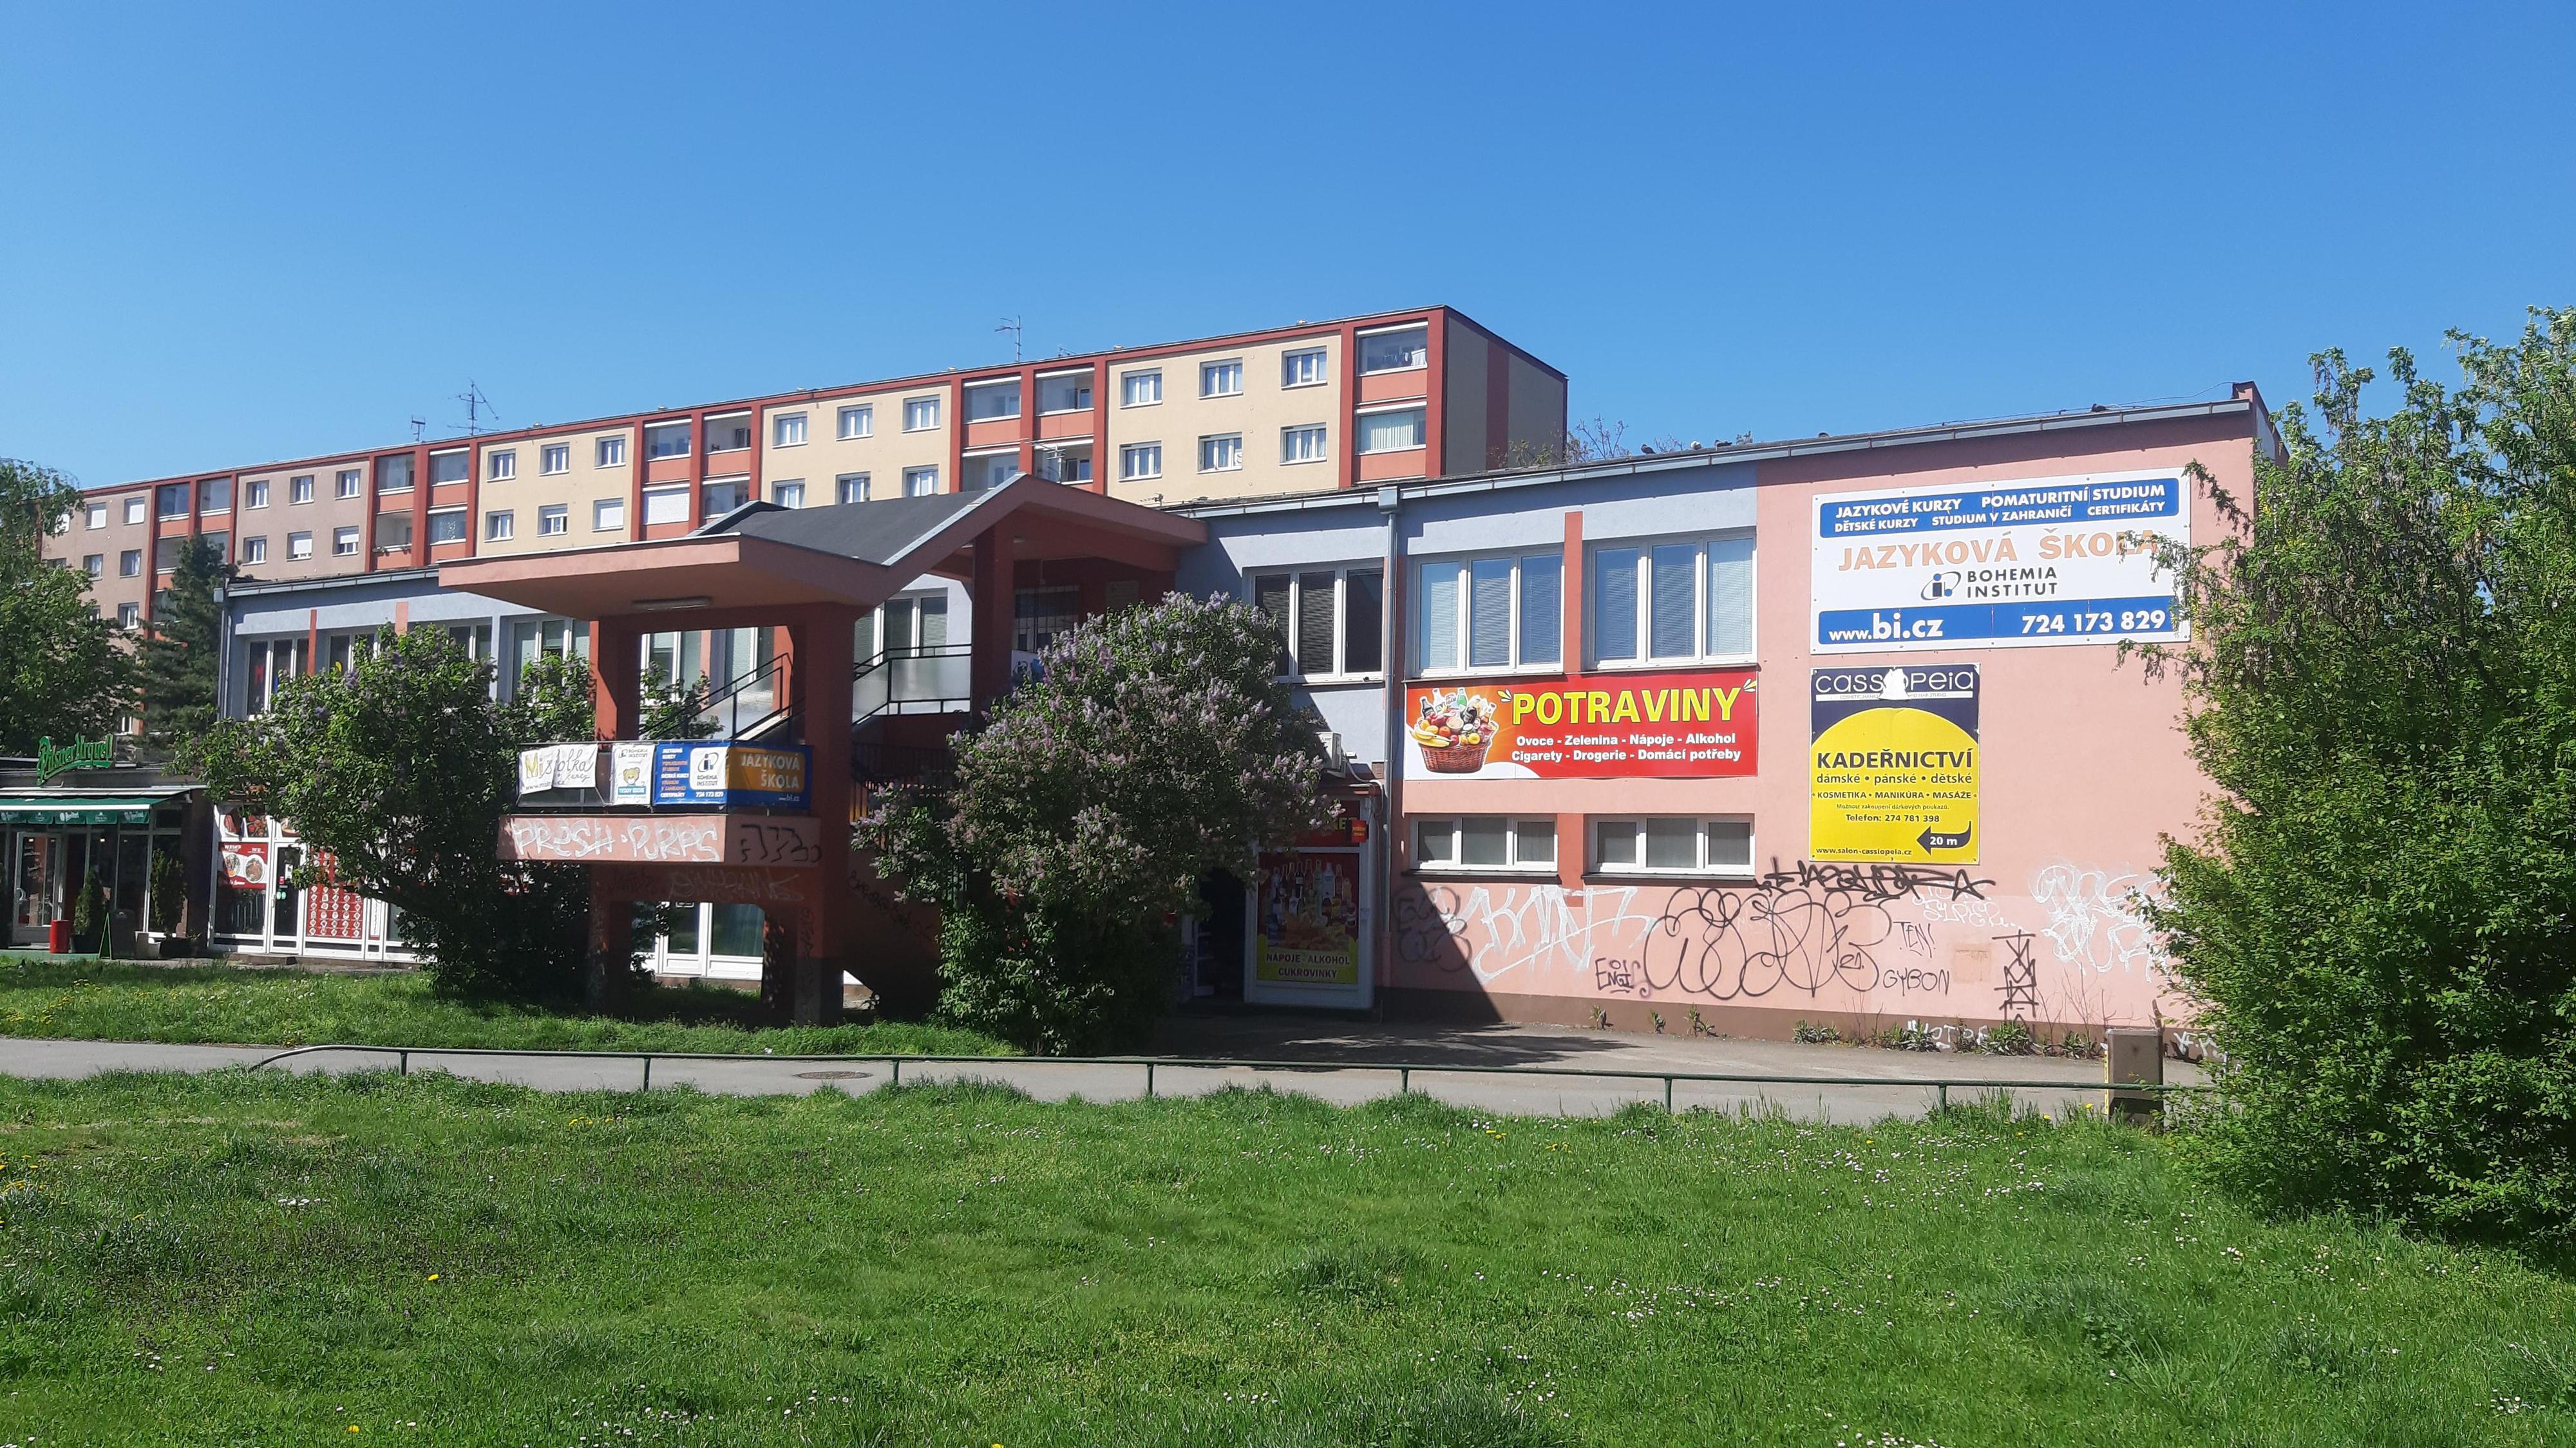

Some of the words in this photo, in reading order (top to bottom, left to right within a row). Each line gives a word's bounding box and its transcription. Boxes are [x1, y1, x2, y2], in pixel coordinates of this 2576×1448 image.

[1835, 499, 1909, 518] JAZYKOVÉ
[1912, 498, 1963, 513] KURZY
[1982, 486, 2088, 508] POMATURITNÍ
[2092, 484, 2166, 501] STUDIUM
[1835, 518, 1877, 532] DĚTSKÉ
[1878, 518, 1919, 530] KURZY
[1932, 514, 1987, 526] STUDIUM
[1989, 512, 1998, 522] V
[2001, 505, 2072, 522] ZAHRANIČÍ
[2087, 500, 2166, 516] CERTIFIKÁTY
[1839, 531, 2018, 571] JAZYKOVÁ
[1967, 567, 2058, 583] BOHEMIA
[1967, 583, 2058, 598] INSTITUT
[1828, 612, 1944, 641] www.bi.cz
[2022, 614, 2065, 634] 724
[2074, 612, 2114, 632] 173
[2121, 610, 2166, 630] 829
[1512, 687, 1741, 726] POTRAVINY
[1516, 736, 1554, 746] Ovoce
[1564, 735, 1618, 745] Zelenina
[1629, 733, 1674, 747] Nápoje
[1685, 733, 1736, 744] Alkohol
[741, 753, 800, 770] JAZYKOVÁ
[1511, 750, 1563, 762] Cigarety
[1573, 750, 1627, 761] Drogerie
[1638, 749, 1686, 760] Domácí
[1690, 748, 1741, 762] potřeby
[1817, 748, 1973, 769] KADEŘNICTVÍ
[761, 769, 799, 789] ŠKOLA
[1817, 774, 1861, 784] dámské
[1874, 773, 1917, 785] pánské
[1931, 773, 1973, 784] dětské
[1933, 790, 1971, 798] MASÁŽE
[1929, 836, 1943, 845] 20
[1815, 847, 1912, 856] www.salon-cassiopeia.cz
[1266, 952, 1301, 963] NÁPOJE
[1307, 955, 1350, 964] ALKOHOL
[1278, 968, 1338, 979] CUKROVINKY
